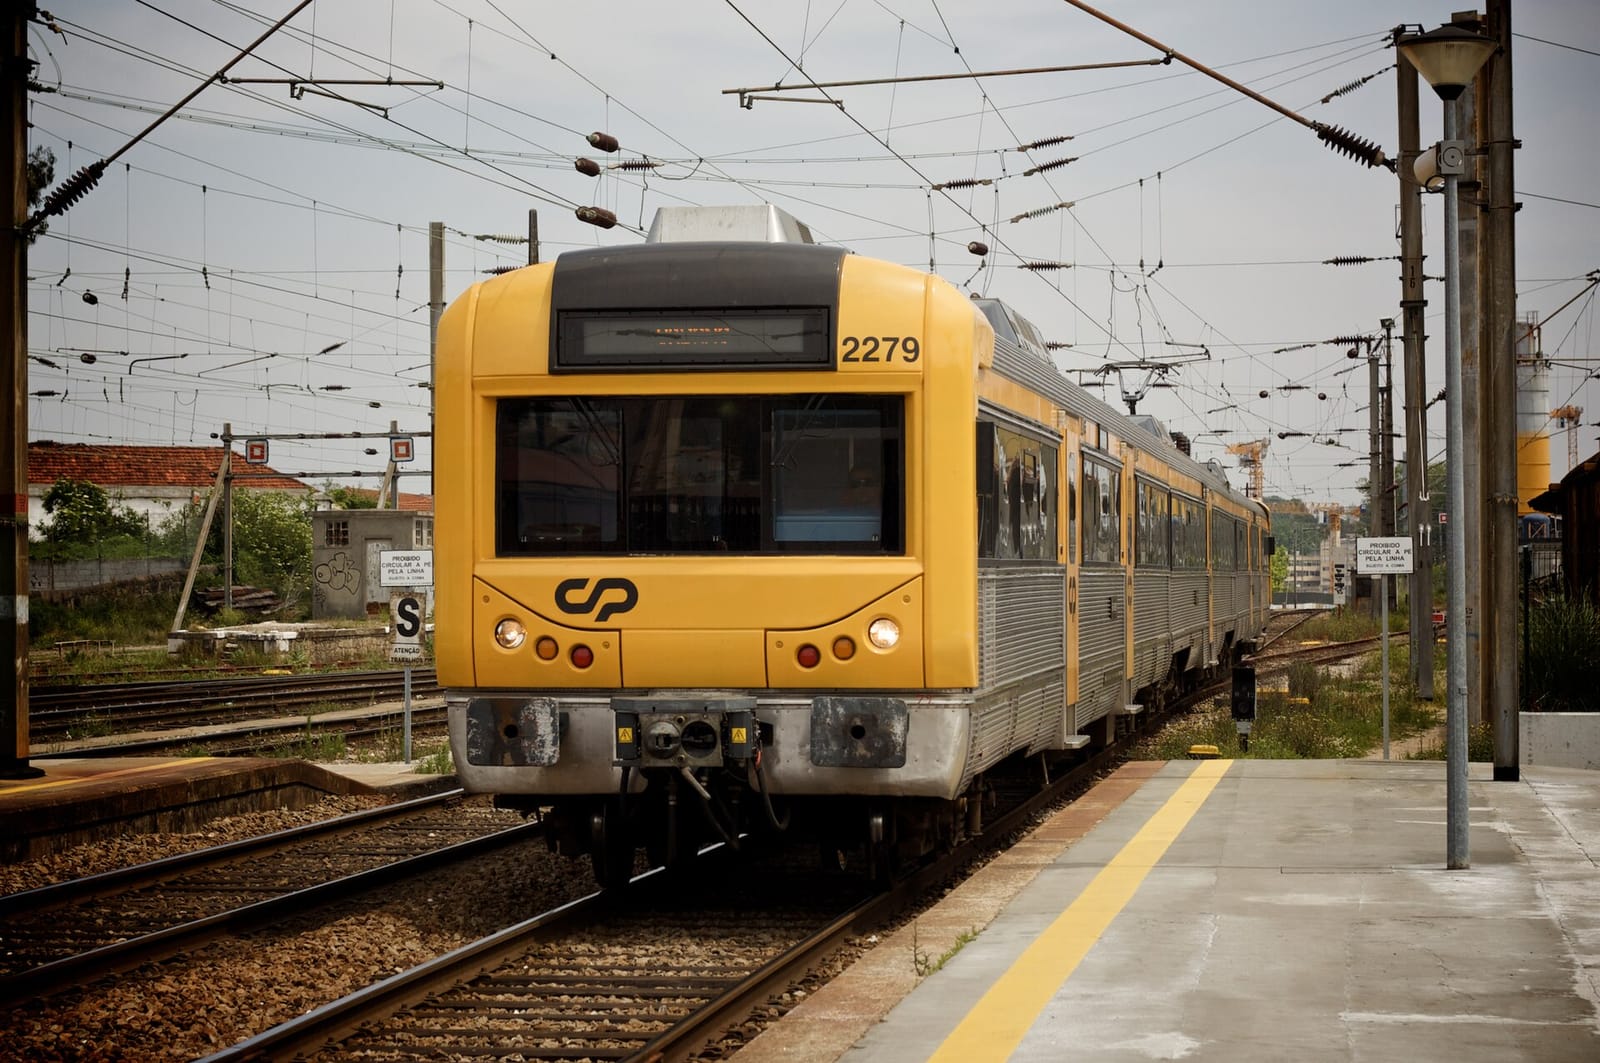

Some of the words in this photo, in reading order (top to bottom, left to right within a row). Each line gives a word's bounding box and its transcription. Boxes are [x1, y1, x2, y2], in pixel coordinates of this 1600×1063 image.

[842, 336, 920, 363] 2279
[396, 597, 420, 637] S
[554, 577, 639, 623] CP
